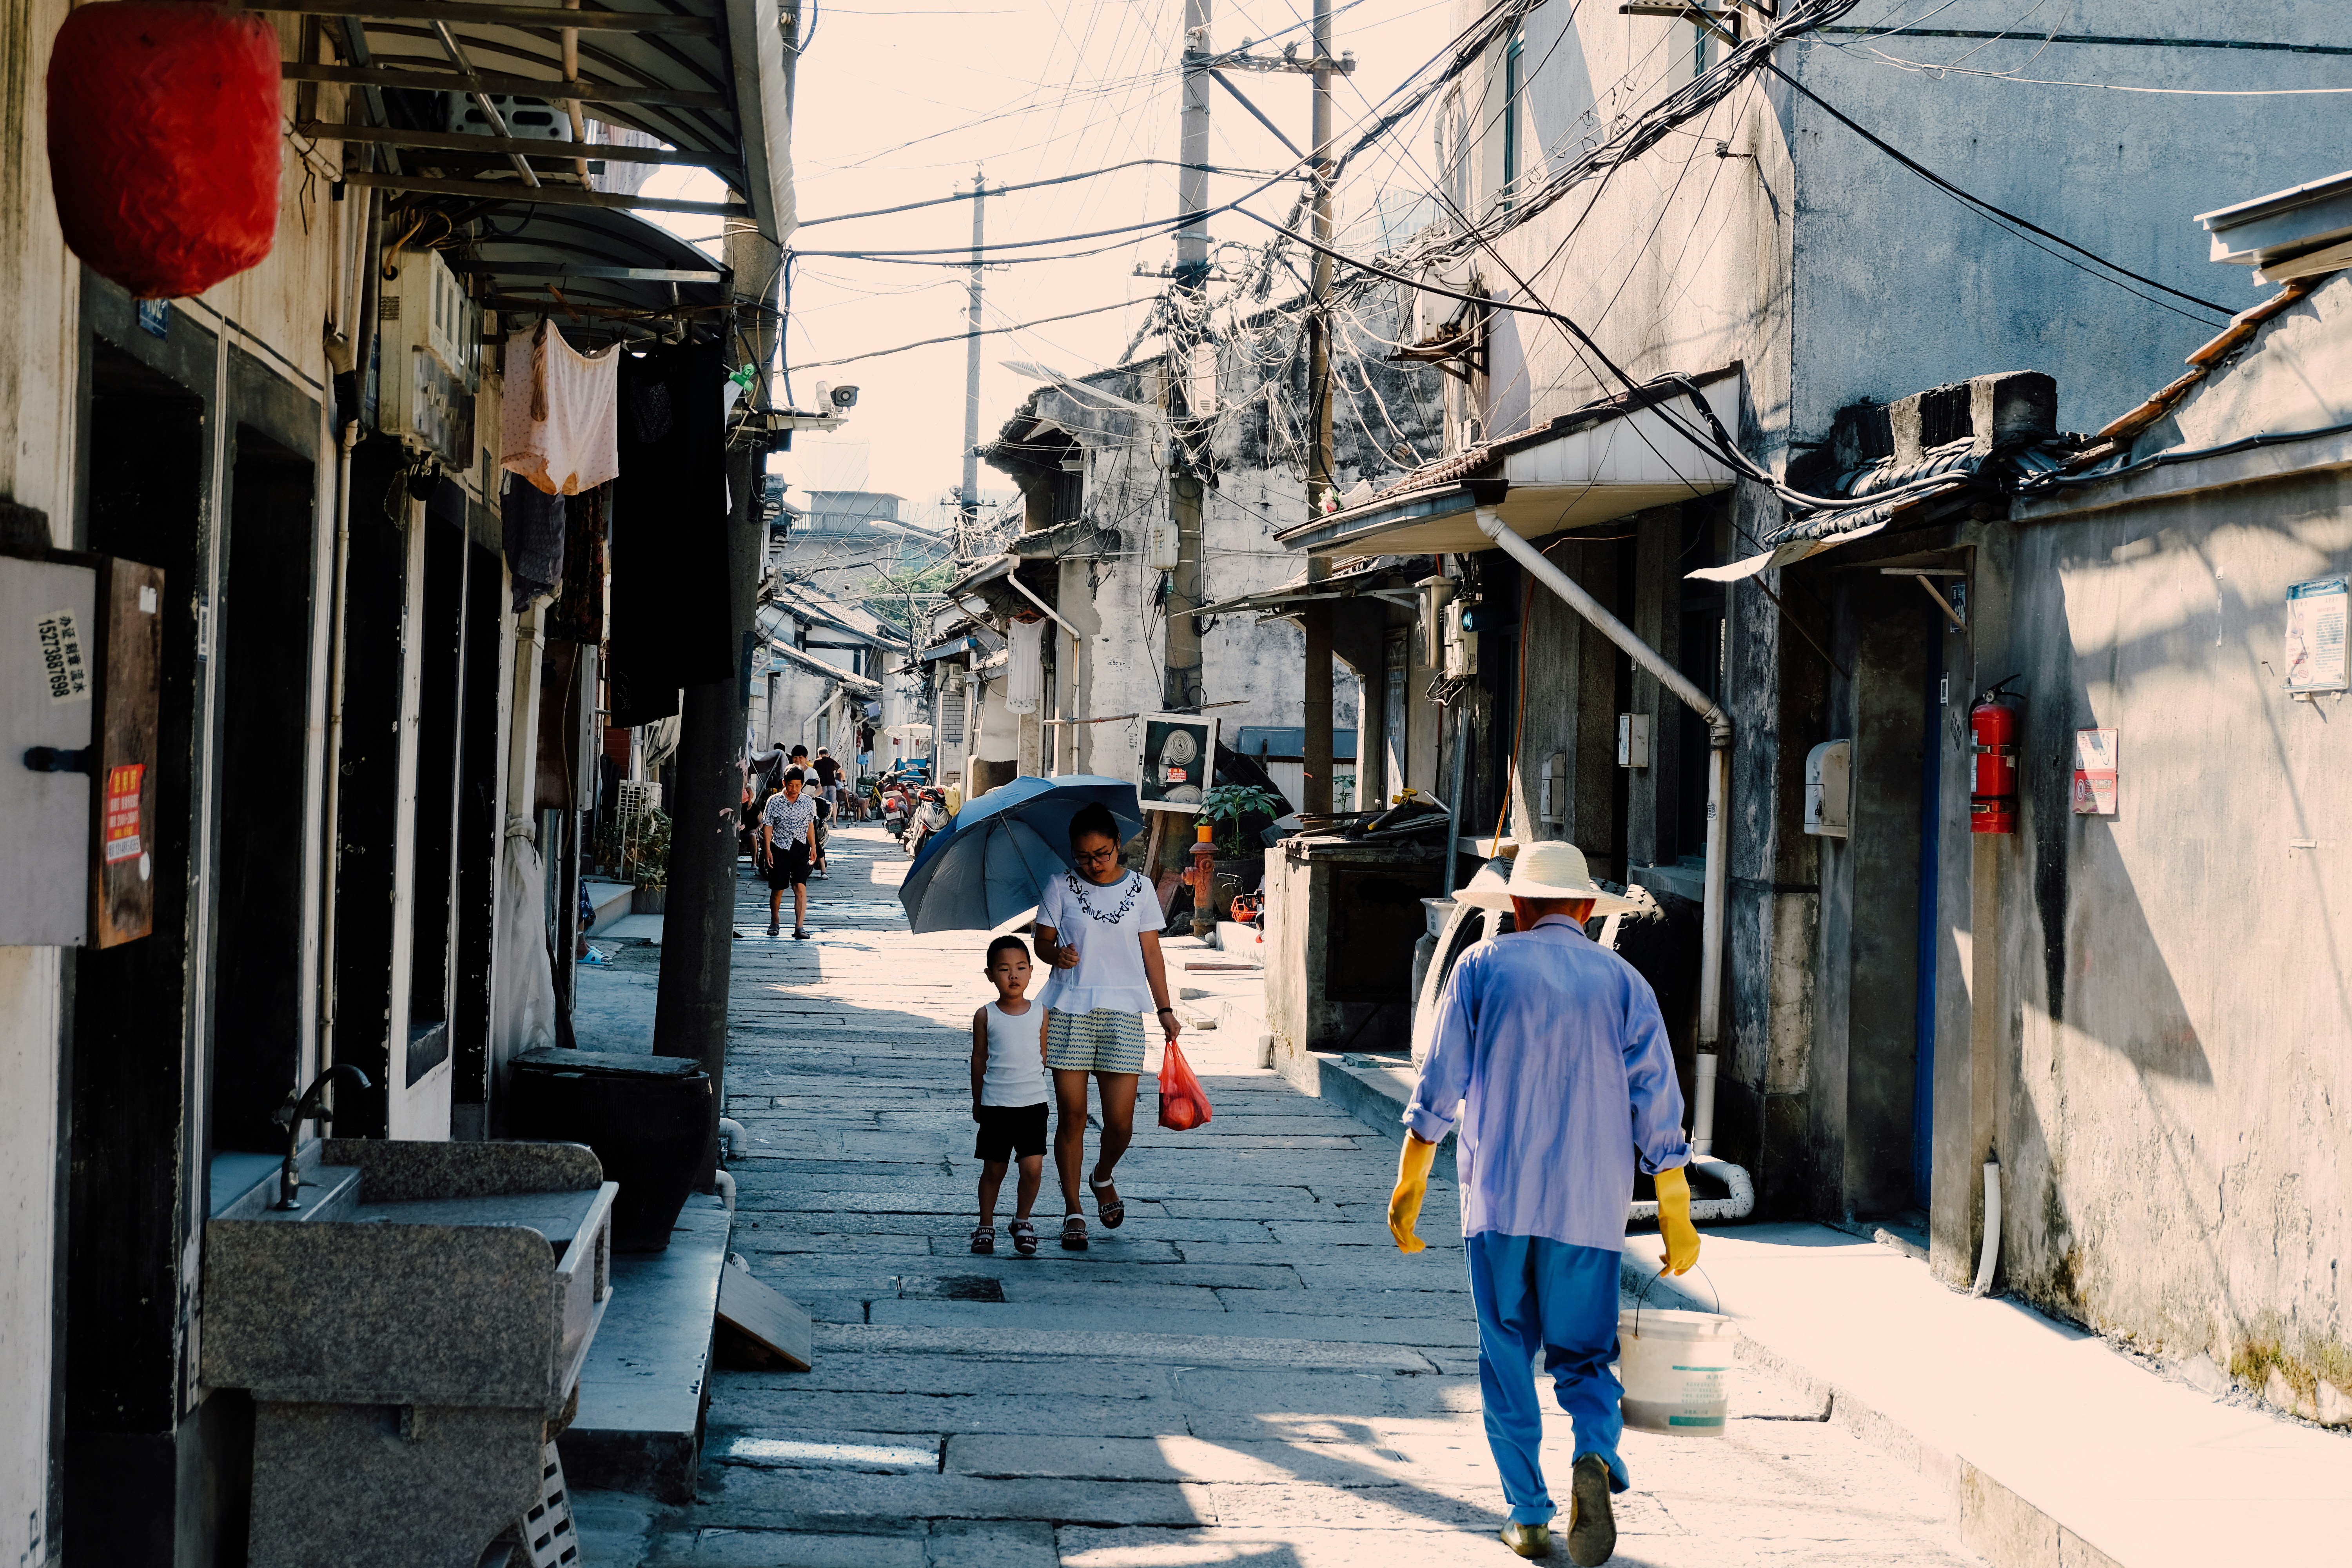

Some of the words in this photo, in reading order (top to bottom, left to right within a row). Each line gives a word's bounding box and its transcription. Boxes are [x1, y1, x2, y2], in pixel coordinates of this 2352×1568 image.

[59, 616, 76, 639] 办证
[38, 619, 71, 698] 15273887698
[65, 642, 82, 666] 刻章
